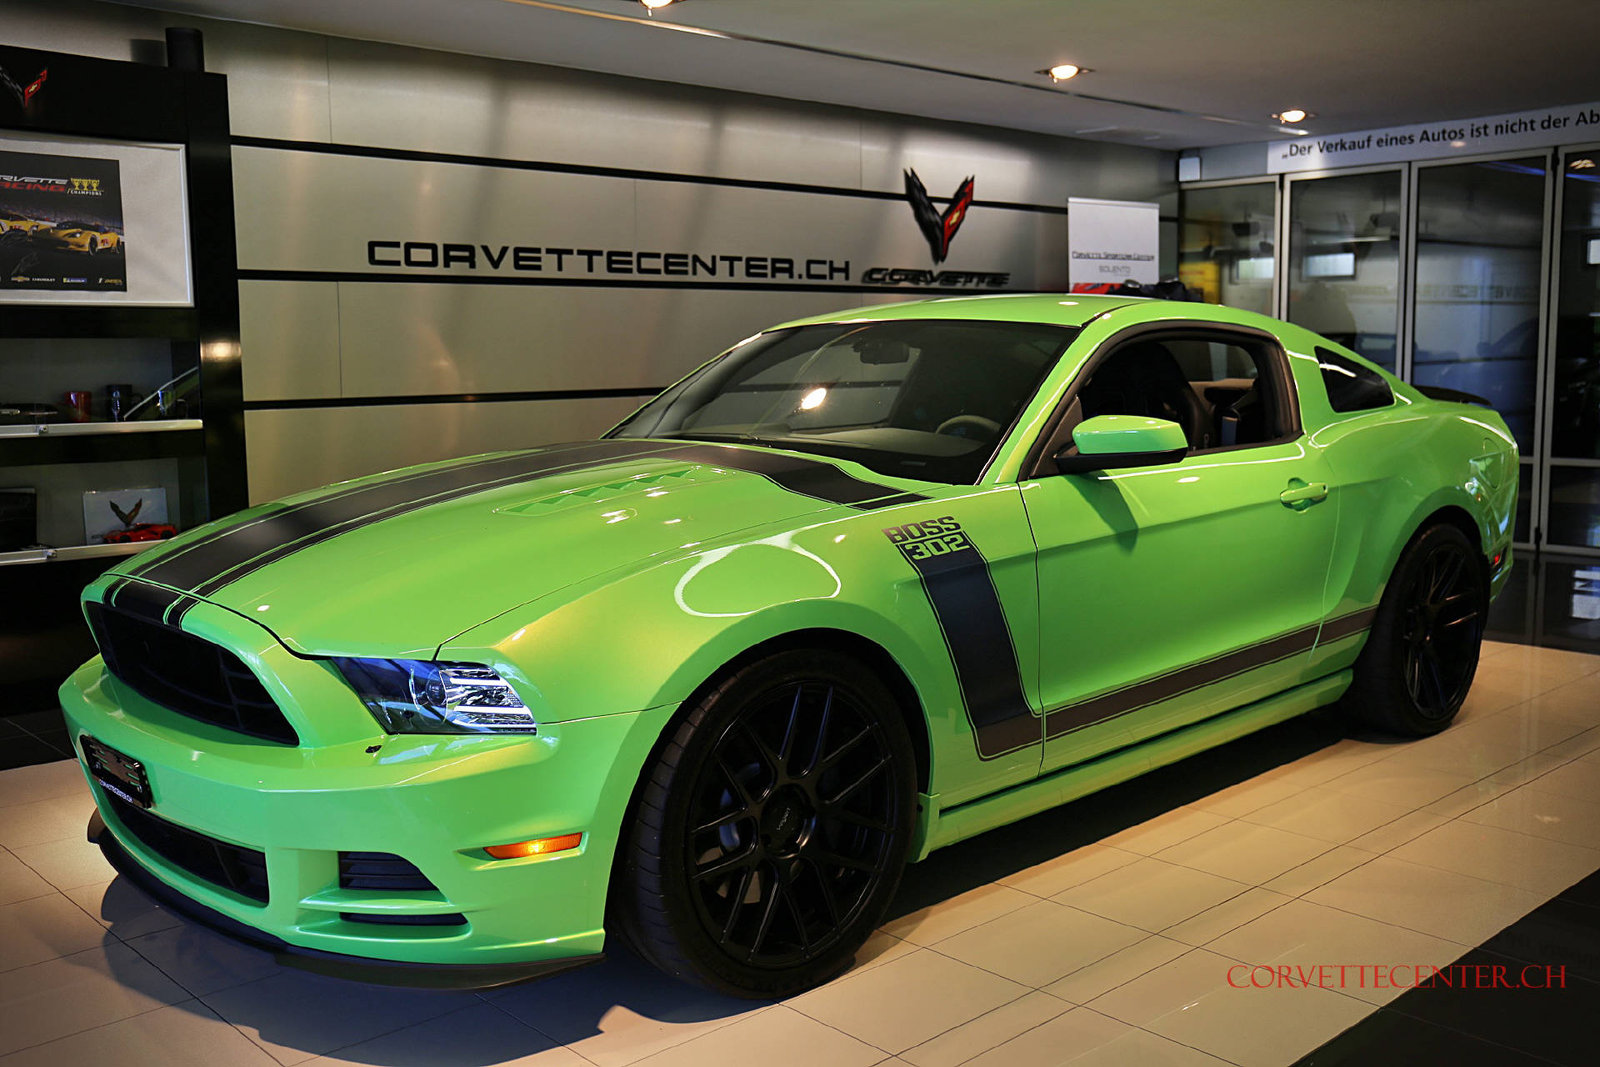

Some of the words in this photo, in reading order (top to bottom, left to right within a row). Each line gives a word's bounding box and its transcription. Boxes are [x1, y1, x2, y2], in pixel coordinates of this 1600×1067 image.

[1317, 135, 1372, 154] Verkauf
[1376, 132, 1415, 148] eines
[1419, 126, 1465, 143] Autos
[1470, 122, 1490, 138] ist
[1494, 118, 1536, 135] nicht
[1540, 114, 1570, 130] der
[367, 240, 850, 281] CORVETTECENTER.CH
[861, 267, 1010, 287] CORVETTE
[881, 516, 961, 544] BOSS
[904, 534, 970, 560] 302
